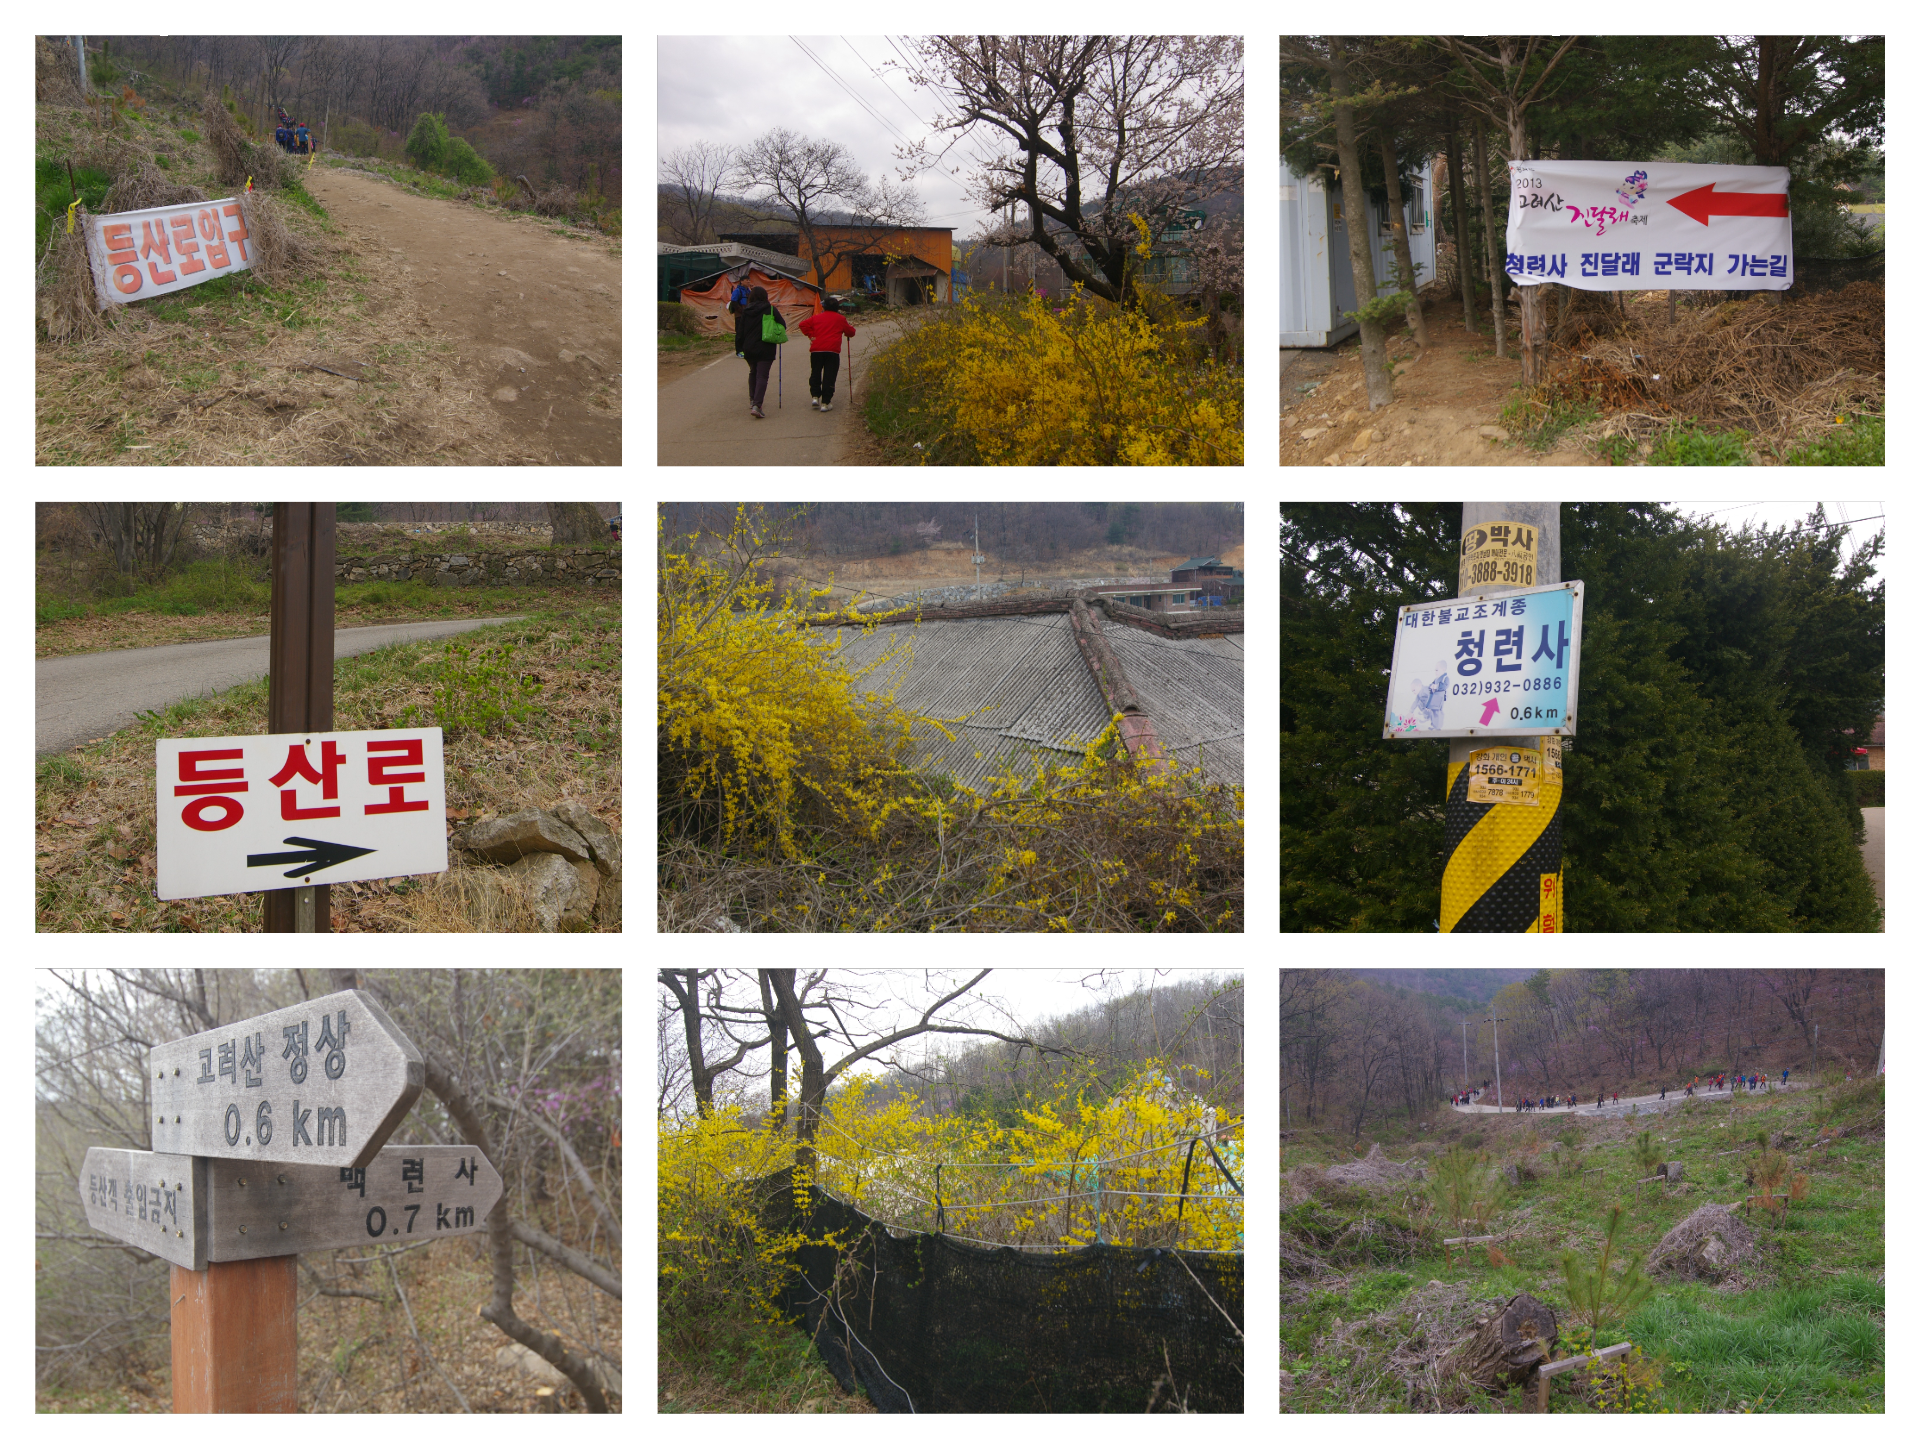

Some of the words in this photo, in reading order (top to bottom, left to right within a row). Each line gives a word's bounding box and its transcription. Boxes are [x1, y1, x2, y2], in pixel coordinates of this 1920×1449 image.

[1516, 178, 1543, 189] 2013
[1519, 192, 1565, 212] 고려산
[1566, 205, 1629, 236] 진달래
[1630, 214, 1648, 226] 축제
[103, 203, 249, 294] 등산로입구
[1505, 252, 1568, 278] 청련사
[1580, 252, 1641, 277] 진달래
[1653, 252, 1713, 276] 군락지
[1727, 253, 1788, 277] 가는길
[1490, 525, 1534, 551] 박사
[1405, 598, 1527, 628] 대한불교조계종
[1454, 620, 1569, 677] 청련사
[1452, 677, 1562, 696] 032)932-0886
[173, 738, 430, 832] 등산로
[1475, 764, 1536, 778] 1566-1771
[197, 1032, 265, 1088] 고려산
[282, 1009, 350, 1084] 정상
[224, 1100, 273, 1147] 0.6
[292, 1100, 347, 1147] km
[89, 1173, 118, 1212] 등산객
[124, 1180, 177, 1225] 출입금지
[366, 1204, 421, 1238] 0.7
[436, 1202, 475, 1231] km
